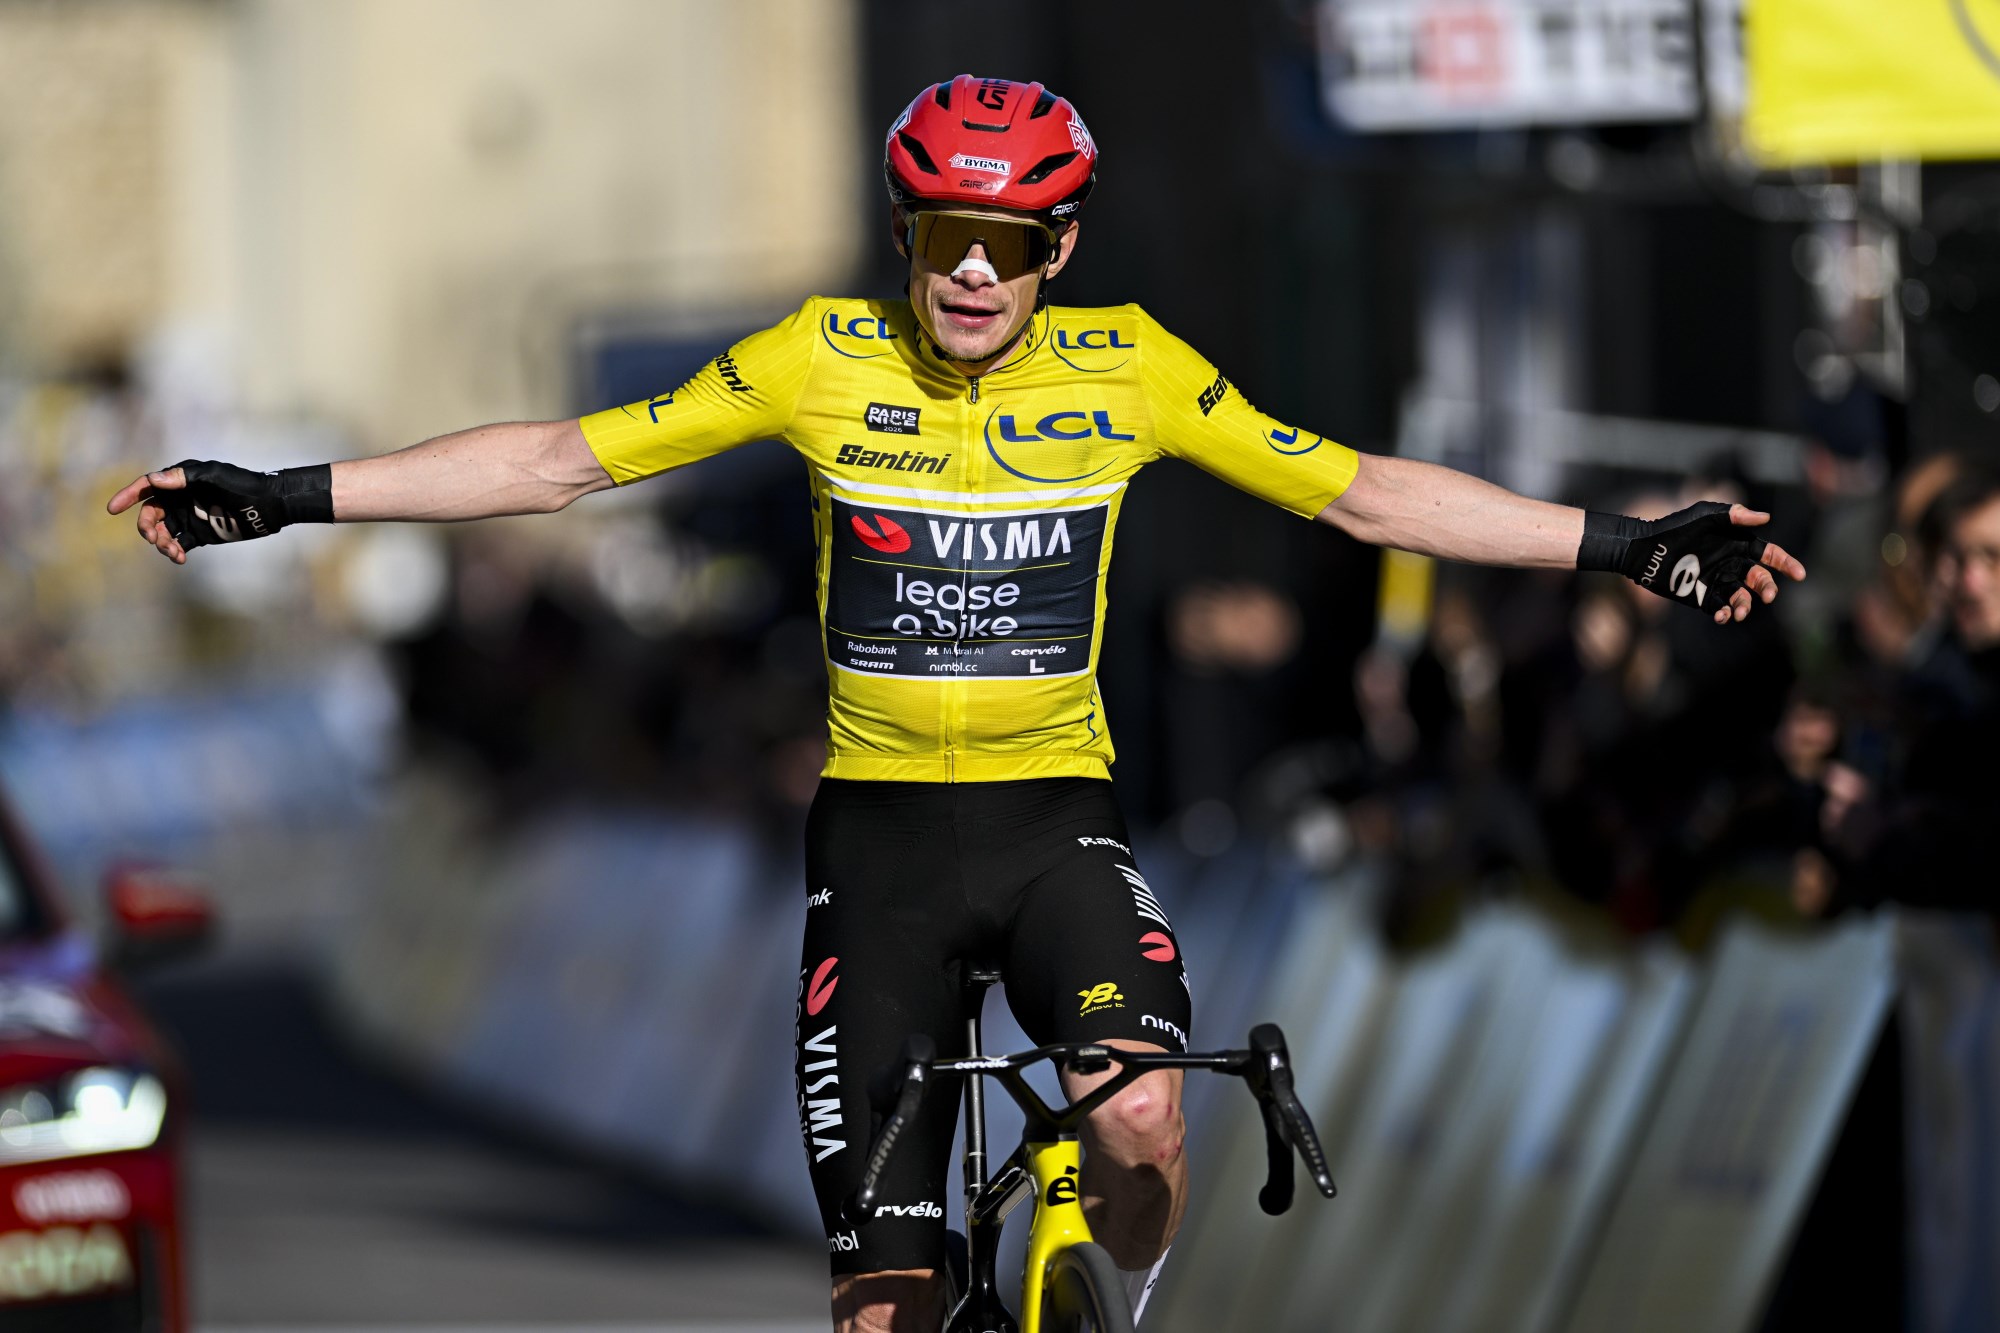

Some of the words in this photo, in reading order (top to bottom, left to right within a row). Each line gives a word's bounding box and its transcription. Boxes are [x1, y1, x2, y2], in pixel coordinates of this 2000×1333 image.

[964, 158, 1009, 174] BYGMA
[959, 179, 993, 191] GIRO
[1051, 201, 1080, 216] GIRO
[829, 313, 898, 340] LCL
[1057, 329, 1135, 350] LCL
[868, 414, 916, 427] NICE
[870, 406, 917, 421] PARIS
[998, 410, 1136, 443] LCL
[835, 443, 952, 475] Santini
[928, 517, 1072, 561] VISMA
[895, 572, 1020, 611] lease
[892, 613, 922, 635] a
[924, 608, 1019, 639] bike
[847, 641, 898, 656] Rabobank
[974, 647, 984, 655] AI
[1011, 644, 1067, 656] cervélo
[850, 658, 894, 670] SRAM
[929, 661, 978, 672] nimbl.cc
[1080, 1004, 1113, 1018] yellow
[805, 1024, 847, 1164] VISMA
[874, 1202, 943, 1218] rvélo
